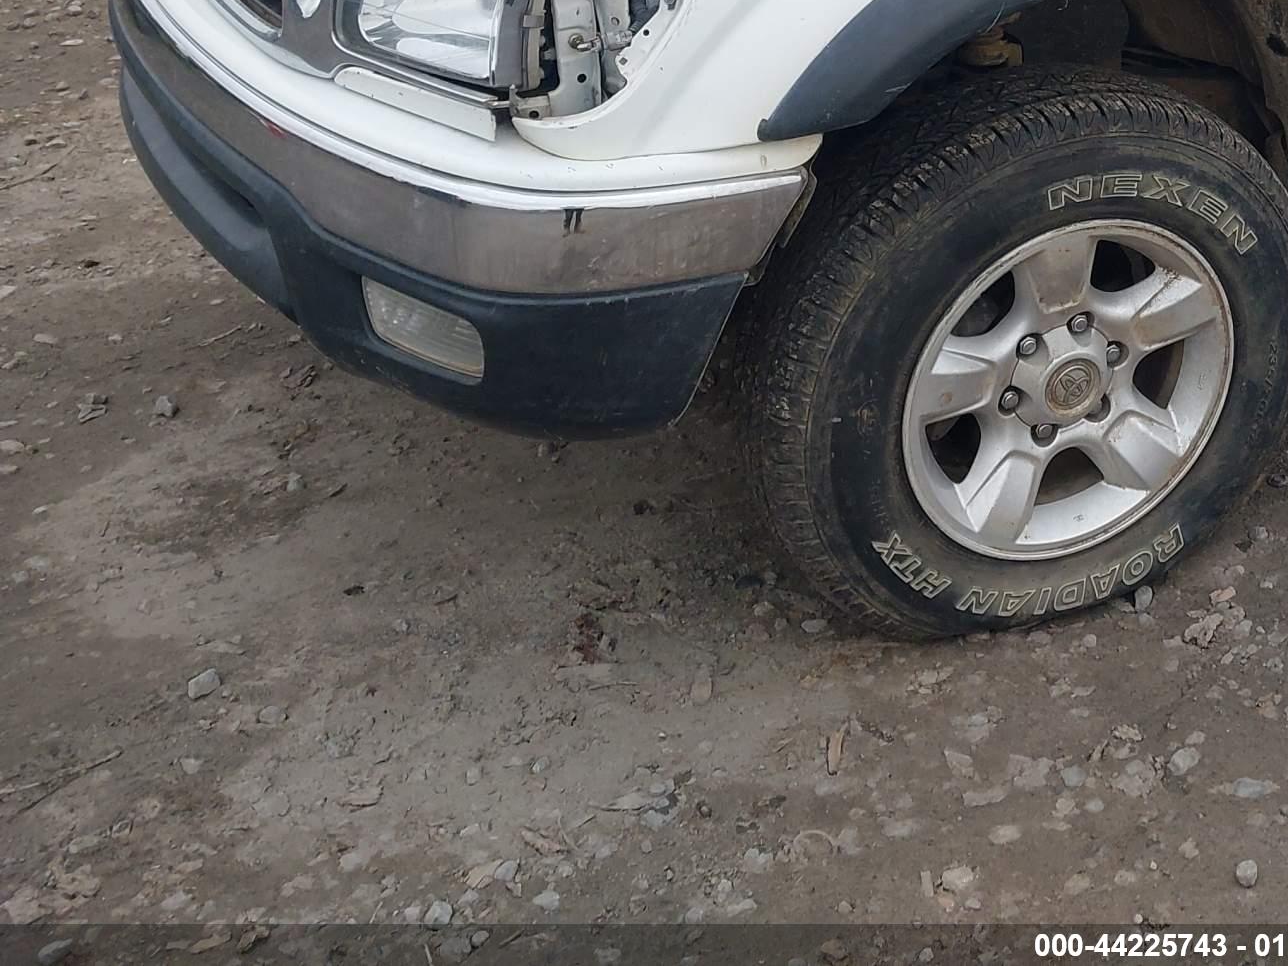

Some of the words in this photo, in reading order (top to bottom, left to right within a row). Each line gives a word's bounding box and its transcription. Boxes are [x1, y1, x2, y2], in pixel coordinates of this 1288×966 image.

[1047, 173, 1259, 256] NEXEN
[871, 530, 952, 600] HTX
[956, 522, 1186, 618] ROADIAN
